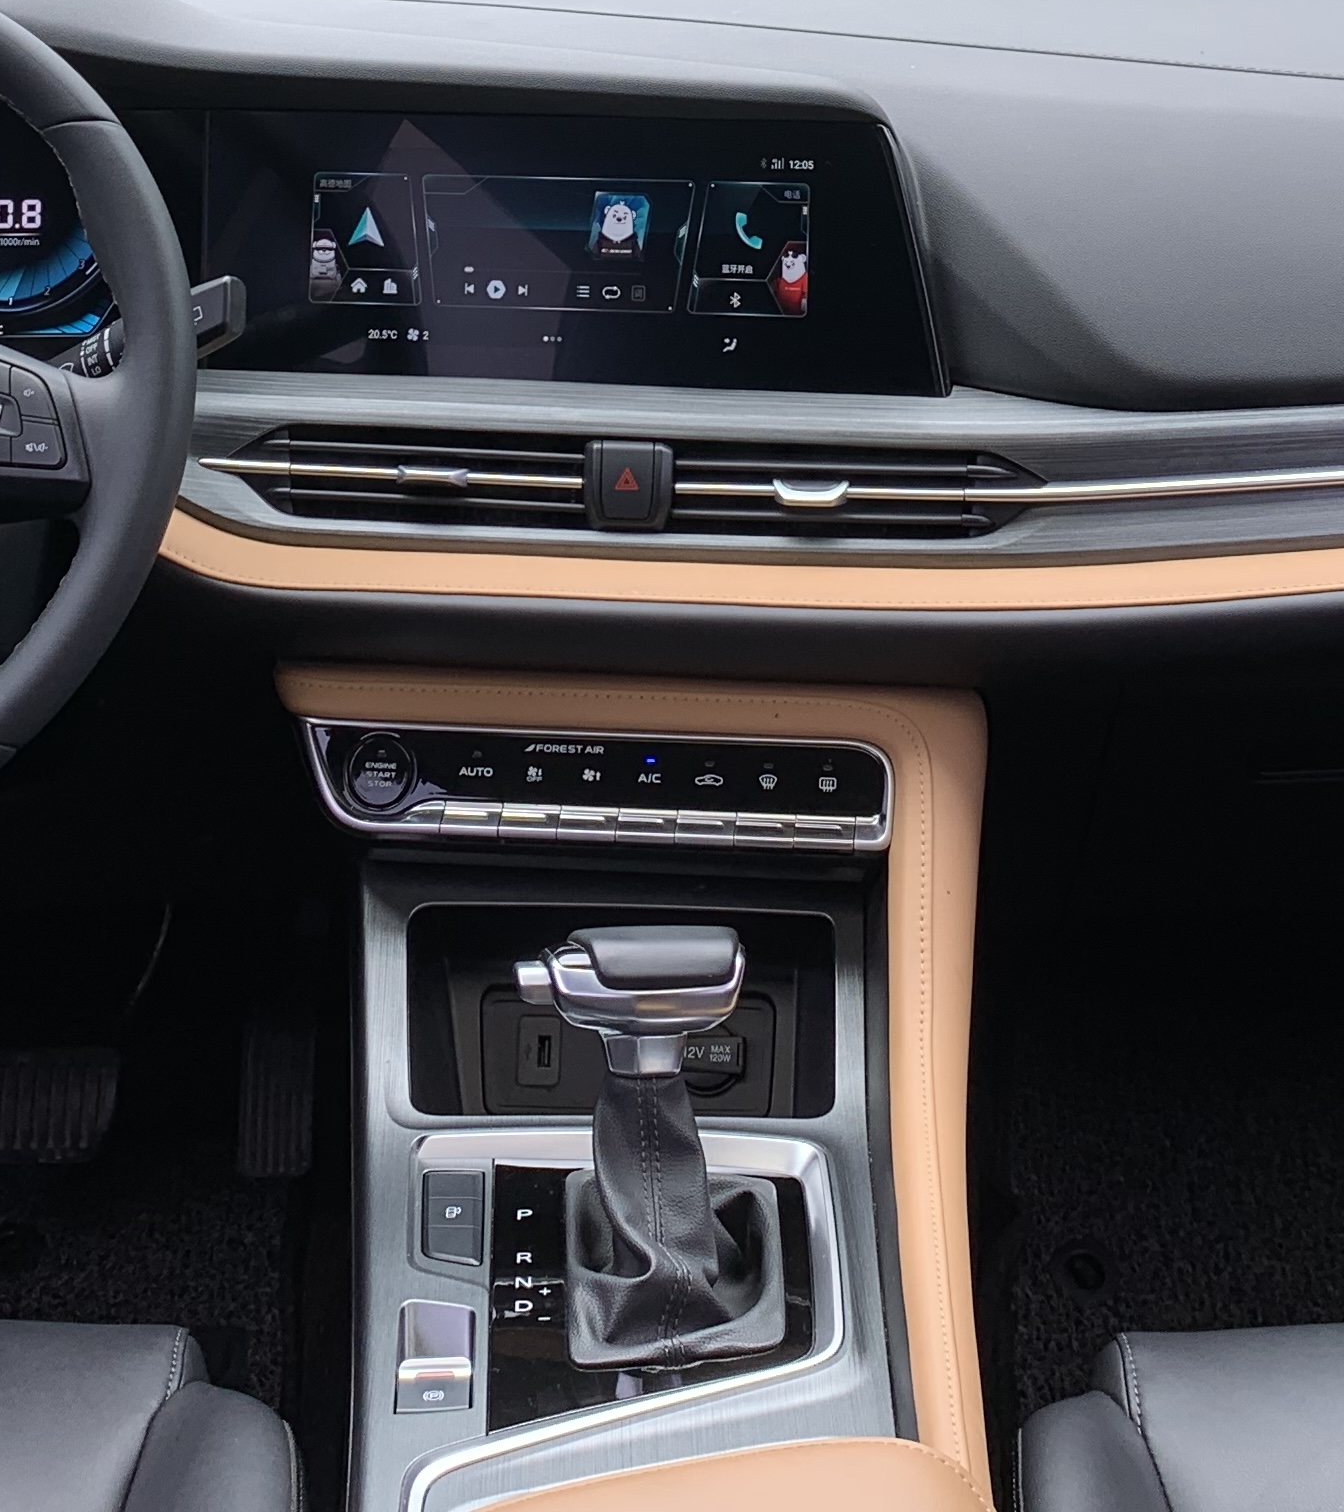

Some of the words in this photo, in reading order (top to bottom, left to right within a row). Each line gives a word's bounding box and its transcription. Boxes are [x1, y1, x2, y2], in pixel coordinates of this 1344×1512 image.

[789, 160, 814, 170] 12:05
[78, 260, 85, 269] 3
[422, 330, 429, 340] 2
[535, 743, 583, 754] FOREST
[584, 745, 605, 754] AIR
[365, 761, 397, 770] ENGINE
[366, 771, 396, 779] START
[459, 766, 493, 777] AUTO
[526, 775, 543, 783] OFF
[638, 773, 661, 783] A/C
[368, 780, 392, 788] STOP
[683, 1046, 705, 1059] 12V
[710, 1045, 731, 1054] MAX
[709, 1054, 732, 1063] 120W
[517, 1209, 533, 1221] P
[516, 1252, 532, 1264] R
[515, 1276, 532, 1289] N
[515, 1300, 533, 1312] D
